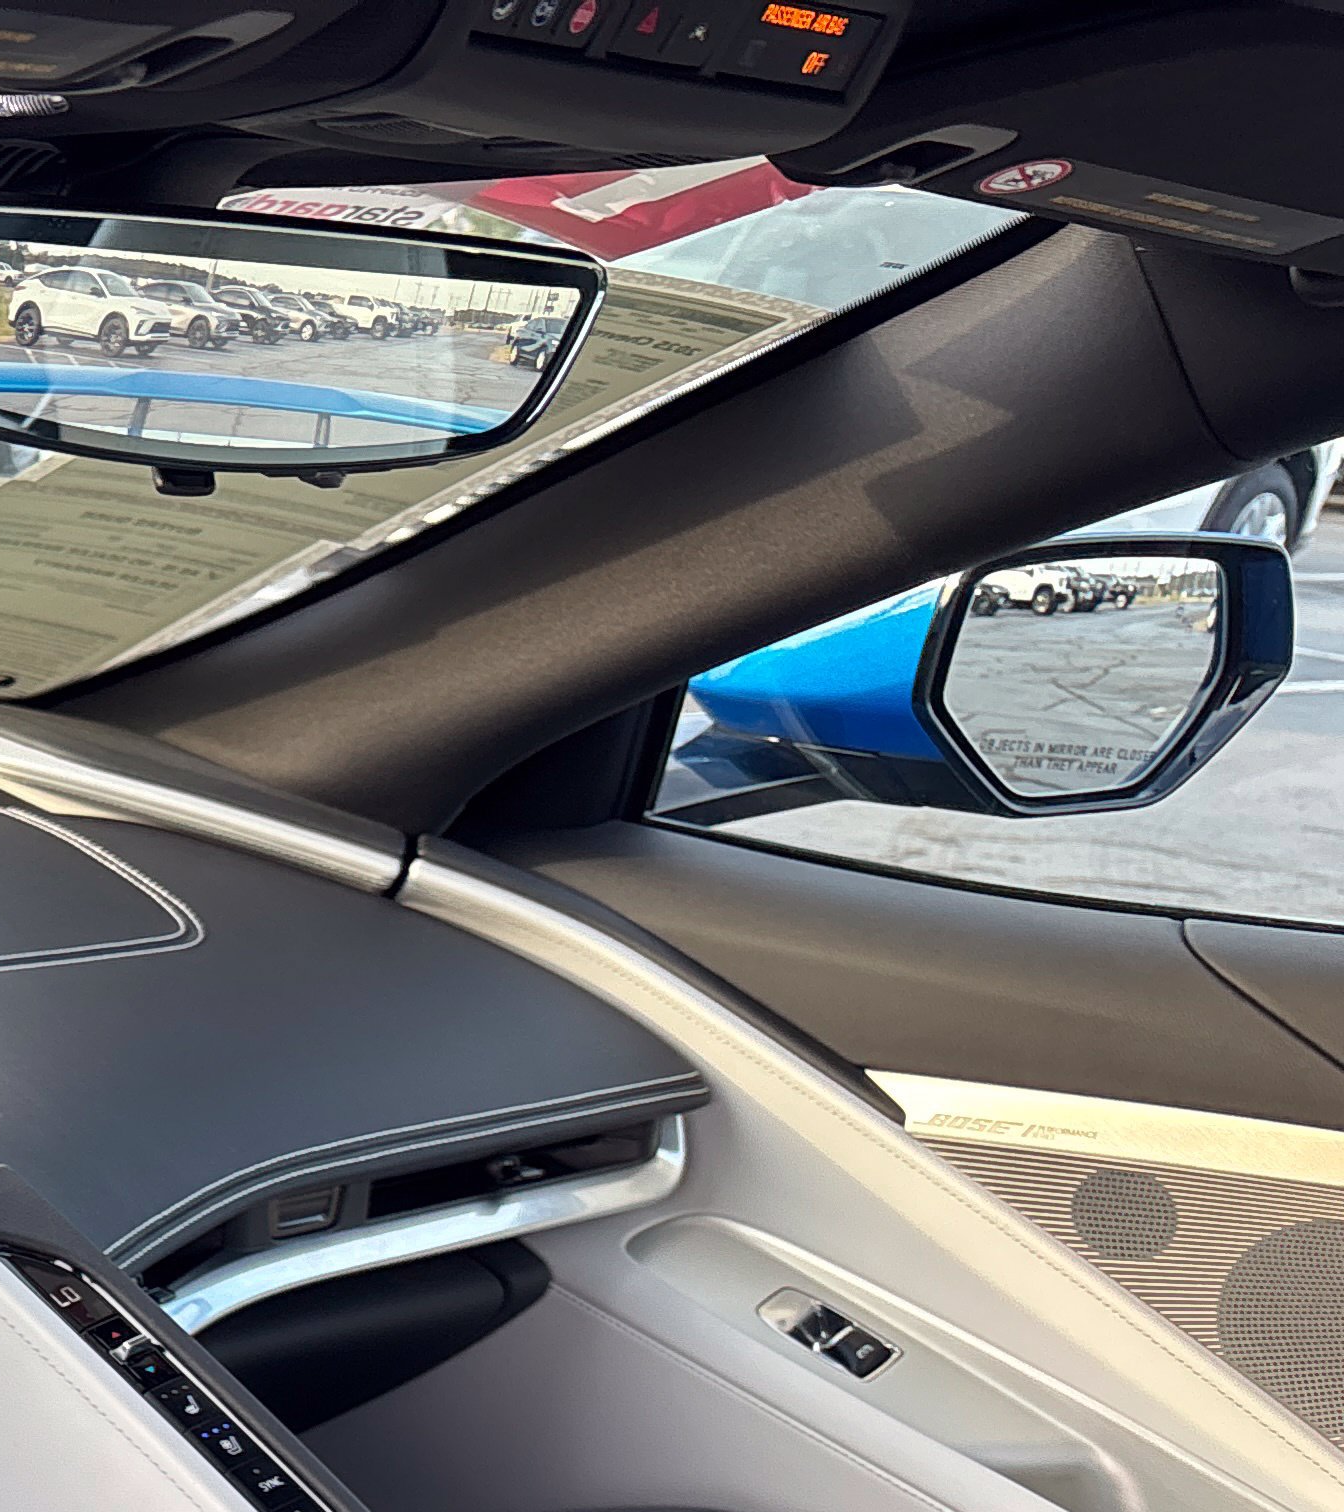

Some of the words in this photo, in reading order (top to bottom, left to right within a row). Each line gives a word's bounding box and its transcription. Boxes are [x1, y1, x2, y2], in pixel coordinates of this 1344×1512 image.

[802, 51, 831, 75] OFF
[979, 738, 1029, 751] OBJECTS
[1034, 743, 1044, 753] IN
[1048, 744, 1090, 756] MIRROR
[1093, 747, 1114, 759] ARE
[1117, 748, 1158, 763] CLOSER
[1014, 755, 1043, 769] THAN
[1047, 758, 1074, 772] THEY
[1078, 761, 1118, 775] APPEAR
[917, 1113, 1023, 1135] BOSE
[49, 1286, 81, 1310] LO
[257, 1475, 285, 1494] SYNC
